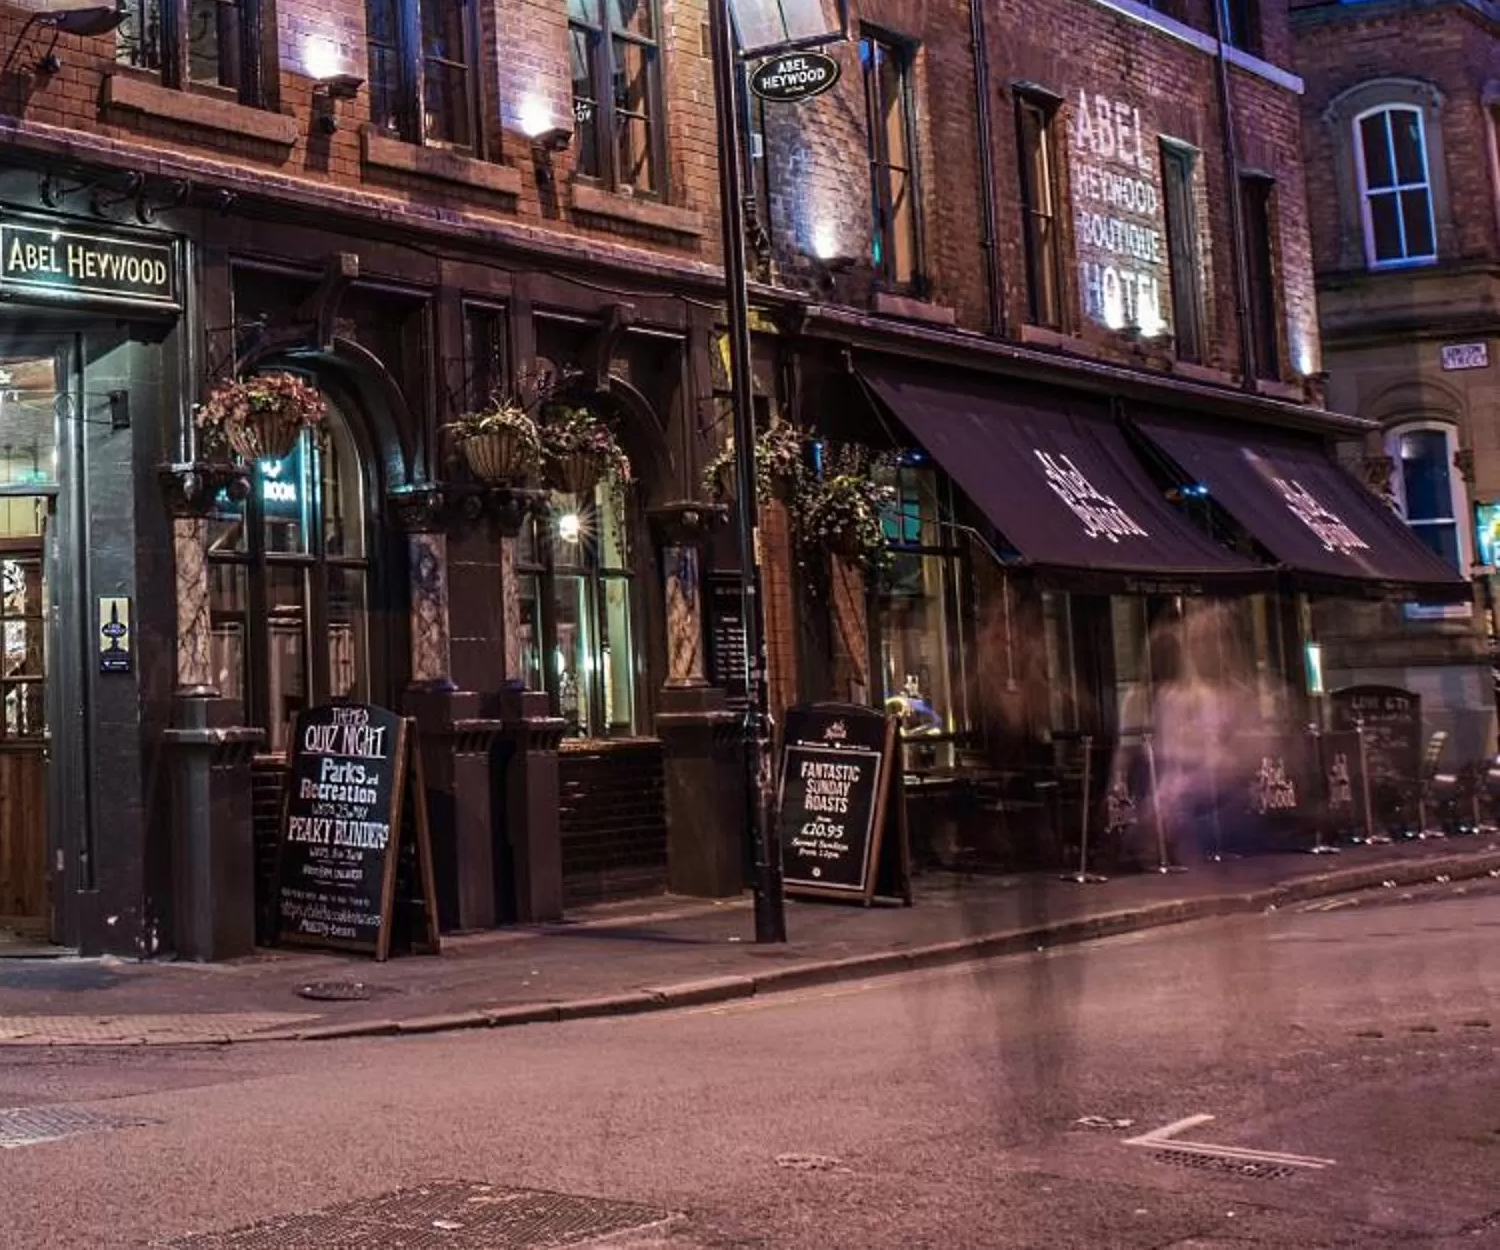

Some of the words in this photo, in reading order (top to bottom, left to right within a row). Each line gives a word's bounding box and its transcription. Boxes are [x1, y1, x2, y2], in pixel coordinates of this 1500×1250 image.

[763, 68, 826, 89] HEYWOOD
[778, 58, 809, 73] ABEL
[1074, 88, 1153, 171] ABEL
[1074, 161, 1158, 216] HEYWOOD
[8, 237, 62, 275] ABEL
[67, 248, 167, 286] HEYWOOD
[1082, 260, 1168, 338] HOTEL
[305, 725, 339, 753] QUIZ
[342, 724, 387, 757] NIGHT
[321, 757, 366, 784] Parks
[801, 761, 861, 782] FANTASTIC
[300, 777, 377, 805] Recreation
[805, 778, 851, 797] SUNDAY
[804, 794, 849, 814] ROASTS
[288, 816, 332, 845] PEAKY
